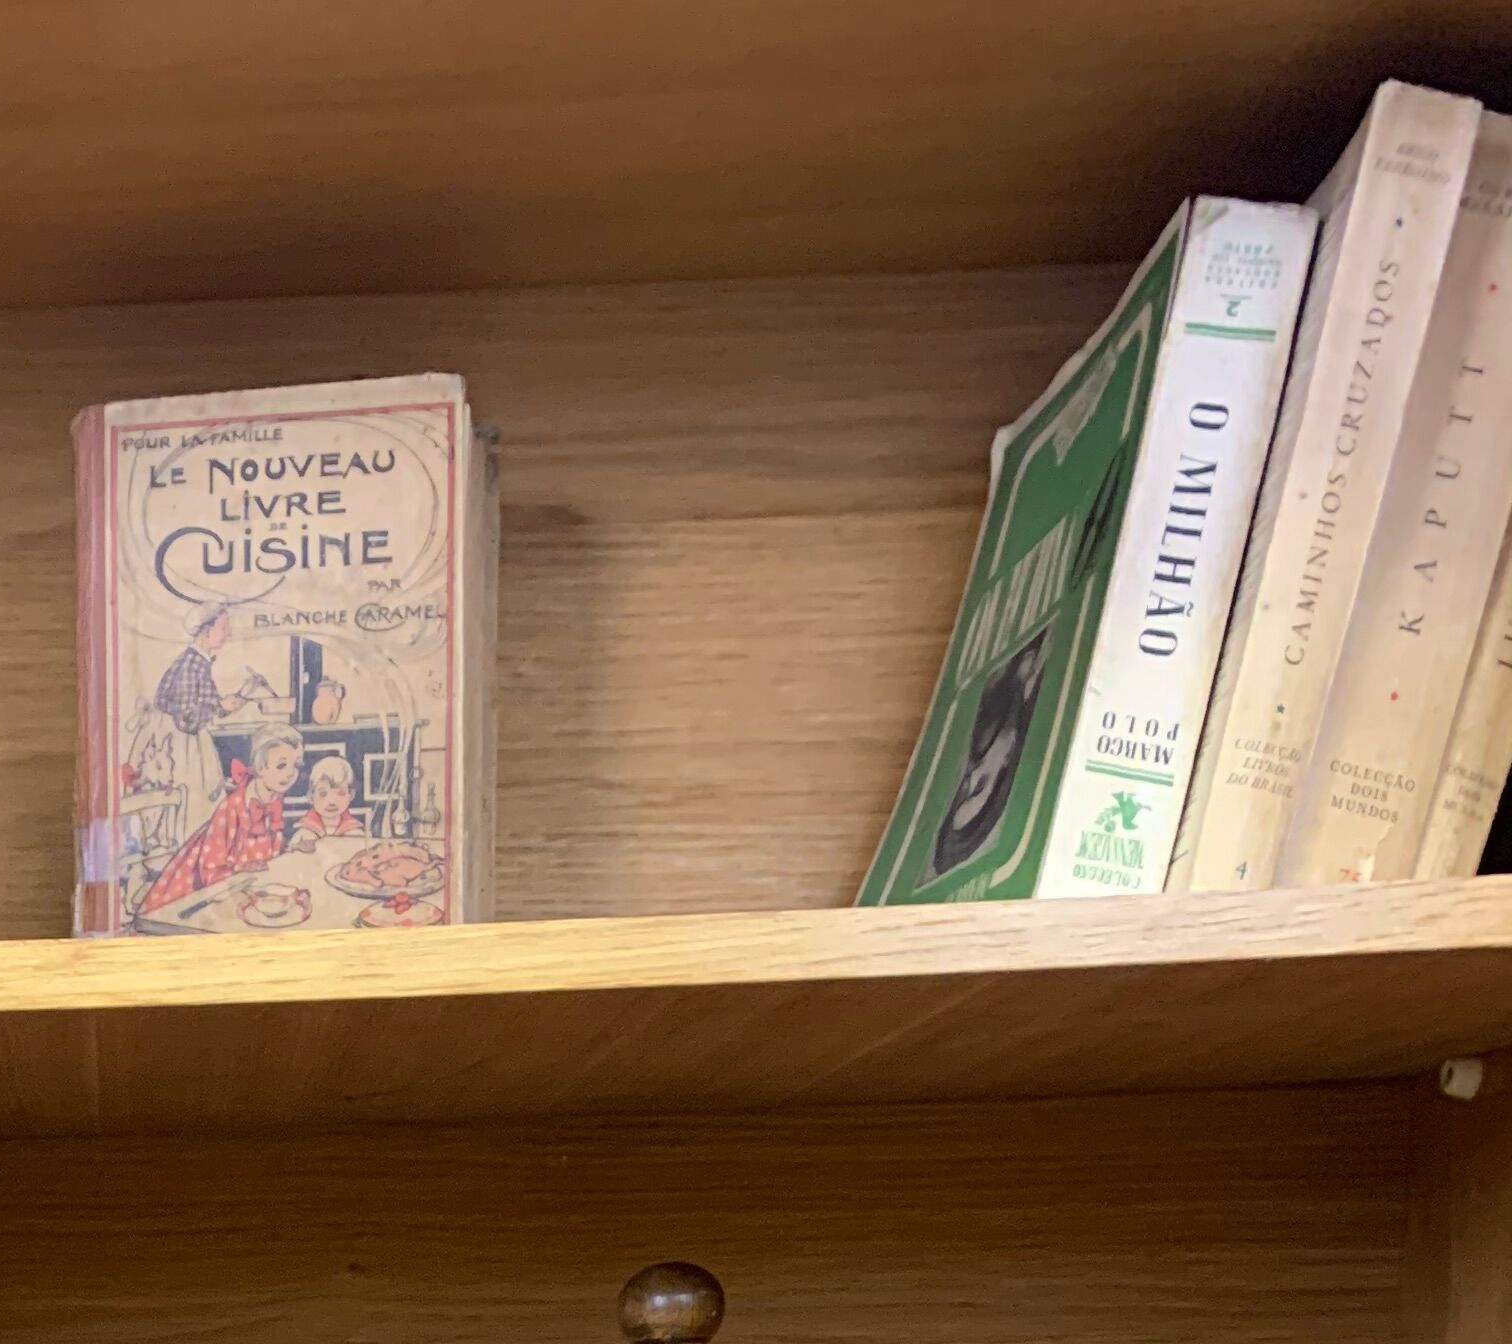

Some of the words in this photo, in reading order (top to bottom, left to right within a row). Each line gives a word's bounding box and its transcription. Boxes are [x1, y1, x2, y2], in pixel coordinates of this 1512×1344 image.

[1225, 300, 1241, 317] 2
[1188, 402, 1230, 430] O
[121, 436, 171, 452] POUR
[207, 427, 284, 447] FAMILLE
[149, 465, 187, 490] LE
[207, 449, 396, 495] NOUVEAU
[1284, 469, 1348, 666] CAMINHOS
[1335, 257, 1401, 457] CRUZADOS
[220, 489, 347, 522] LIVRE
[1397, 360, 1484, 637] KAPUTT
[1138, 452, 1219, 657] MILHÃO
[367, 578, 403, 593] PAR
[253, 610, 349, 629] BLANCHE
[1101, 711, 1181, 742] POLO
[1096, 734, 1175, 766] MARCO
[1328, 759, 1417, 794] COLECÇÃO
[1349, 782, 1389, 803] DOIS
[1330, 795, 1400, 825] MUNDOS
[1235, 860, 1248, 881] 4
